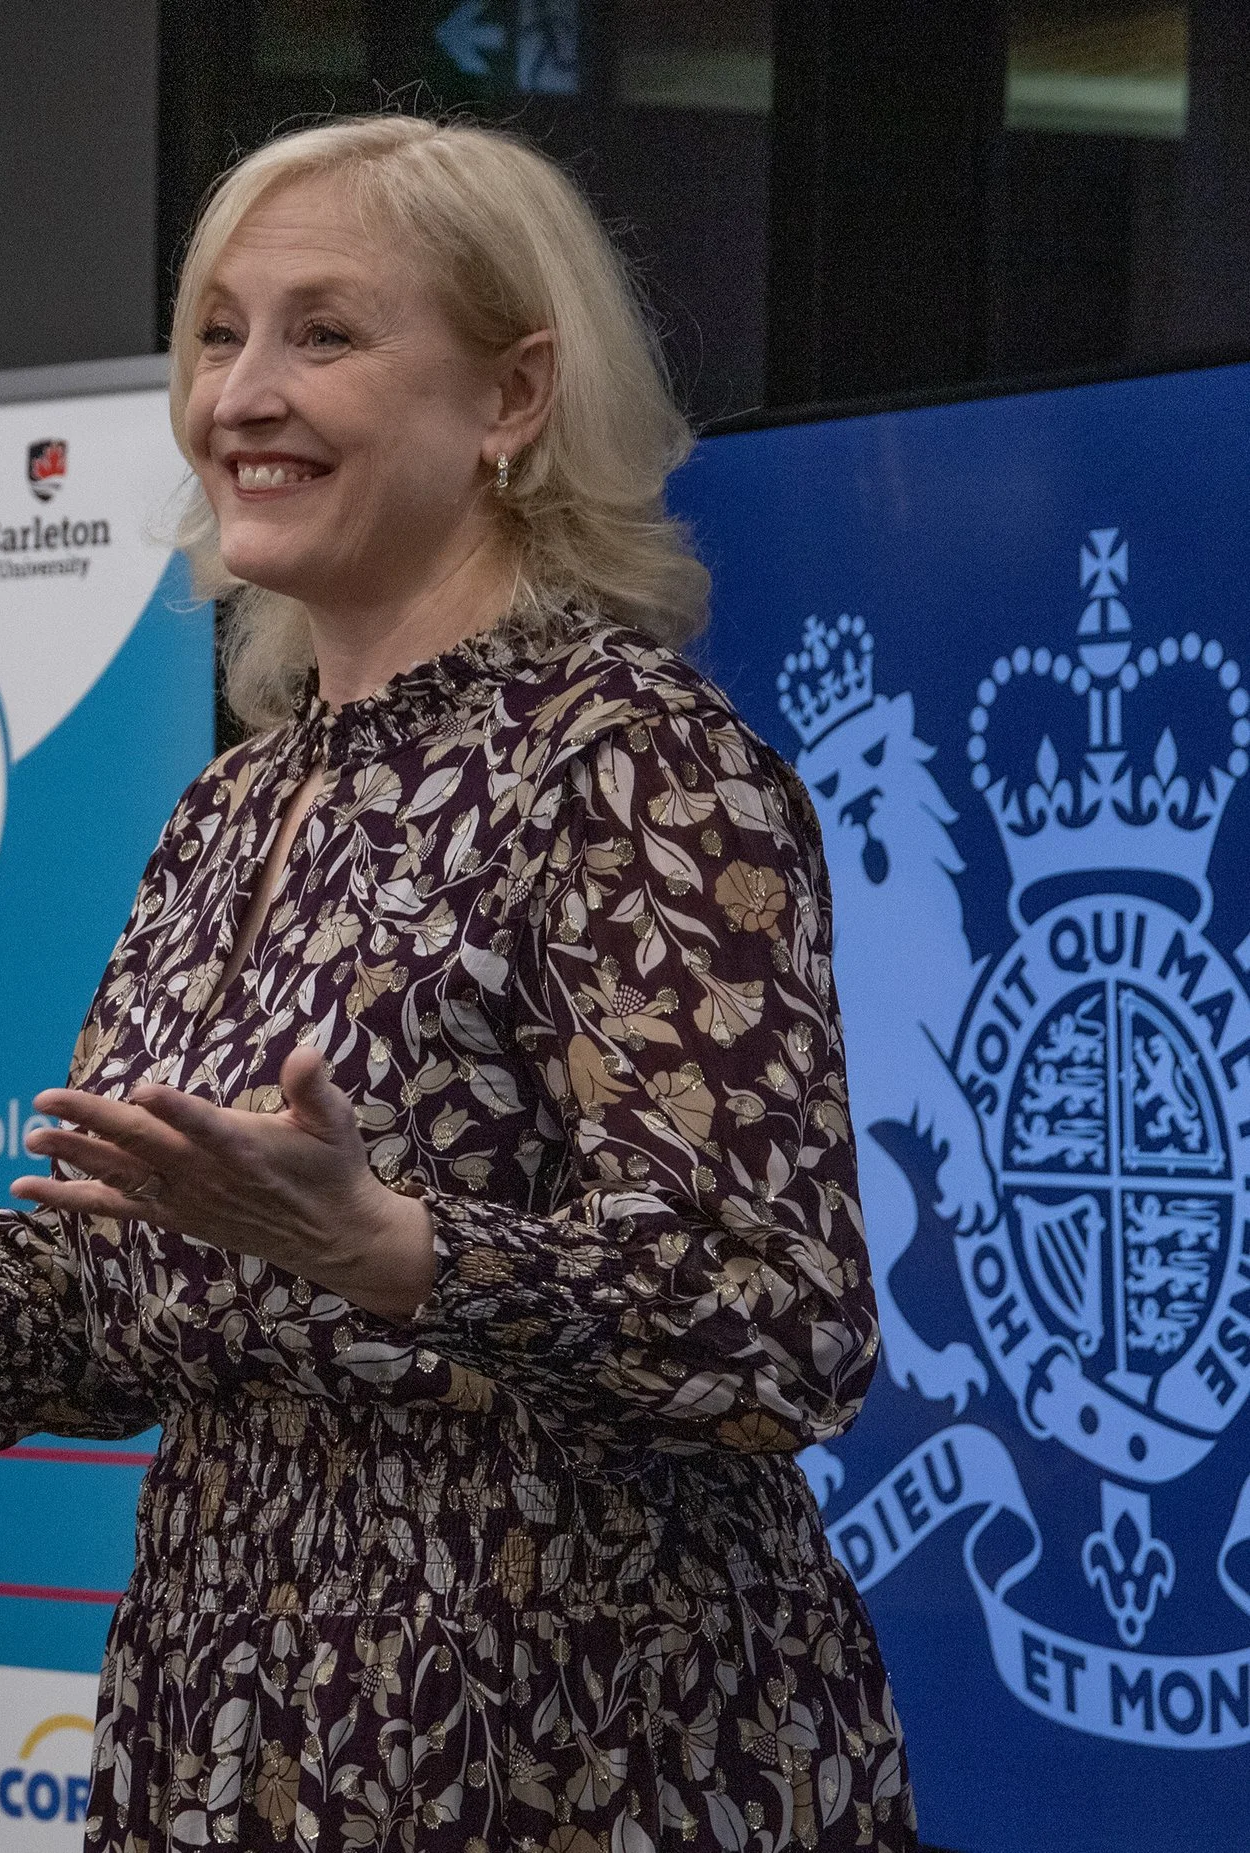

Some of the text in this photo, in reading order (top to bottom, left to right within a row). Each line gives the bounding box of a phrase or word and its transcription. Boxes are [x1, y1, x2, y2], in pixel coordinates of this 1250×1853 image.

[964, 955, 1037, 1116] SOIT
[1049, 910, 1146, 973] QUI
[838, 1440, 964, 1583] DIEU
[1022, 1630, 1250, 1736] ET MON
